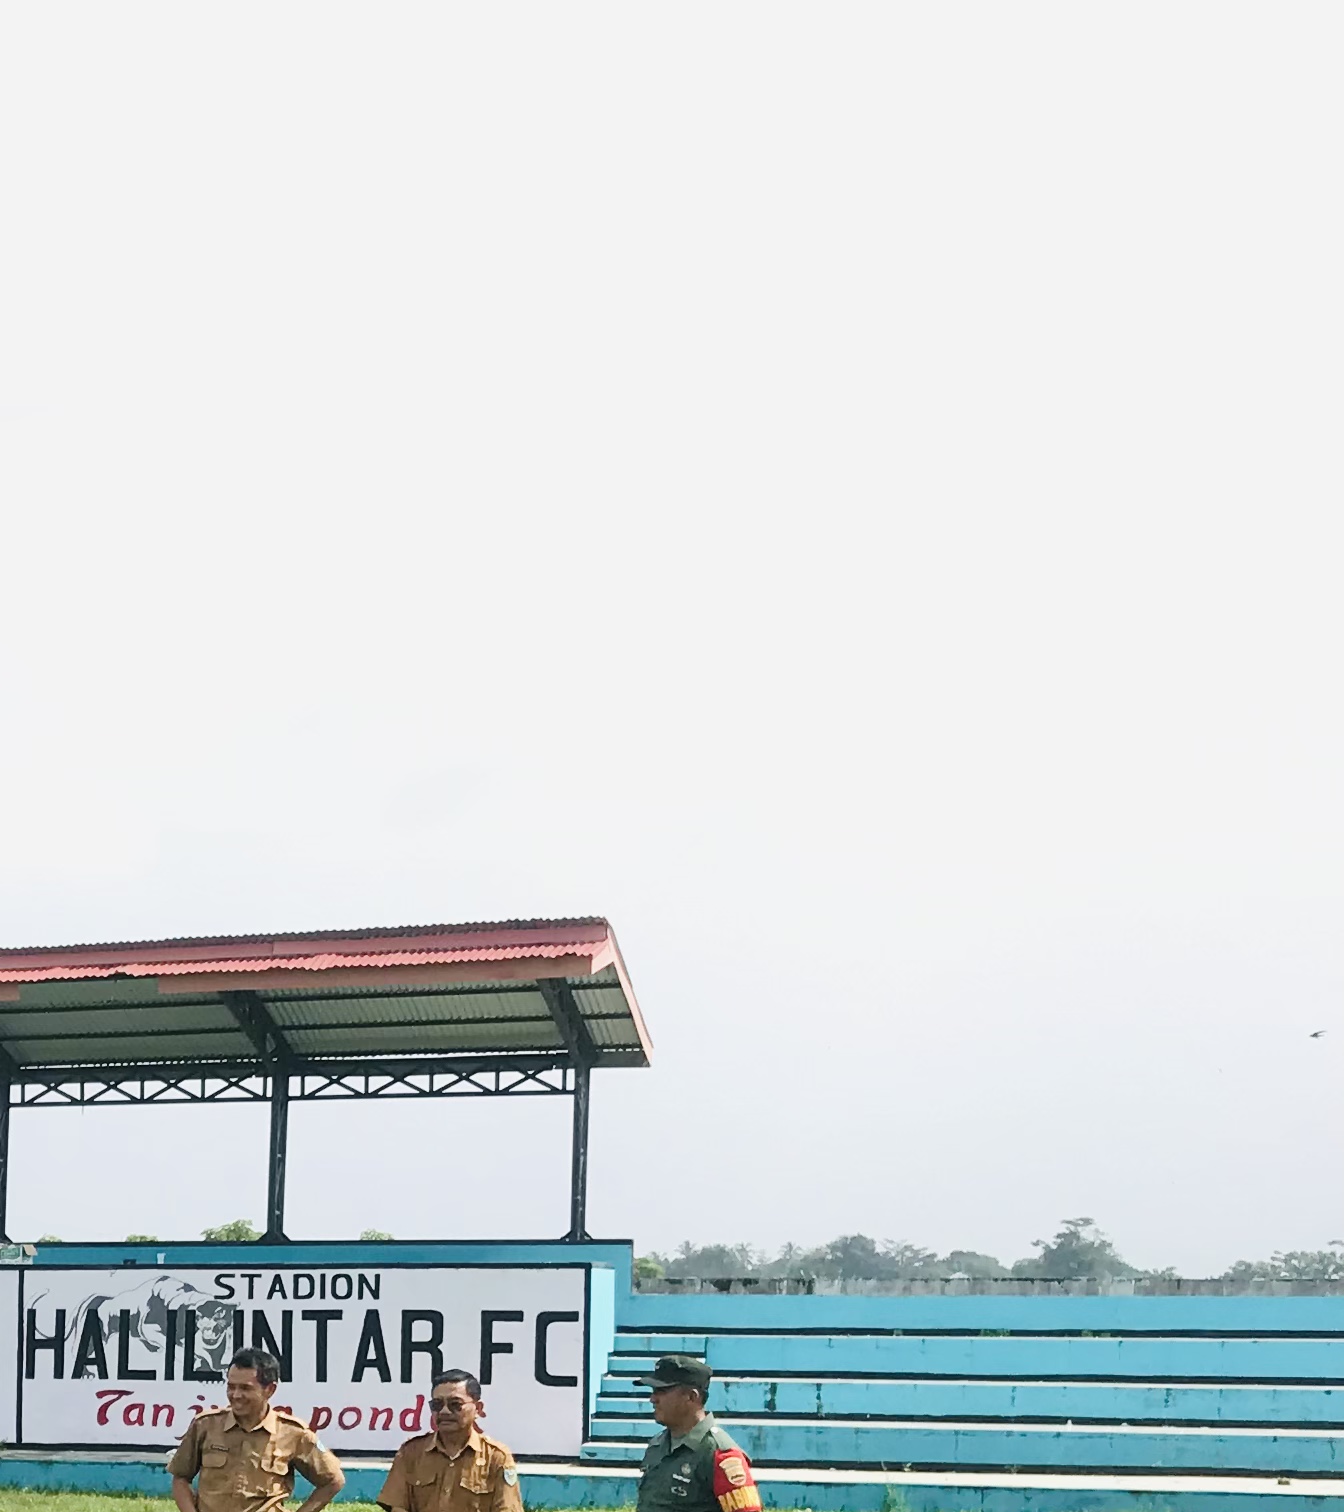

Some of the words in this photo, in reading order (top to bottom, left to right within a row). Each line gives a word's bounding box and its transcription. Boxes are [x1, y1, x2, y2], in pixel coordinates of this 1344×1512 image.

[214, 1273, 381, 1301] STADION
[25, 1308, 445, 1384] HALILINTAR
[479, 1309, 580, 1387] FC
